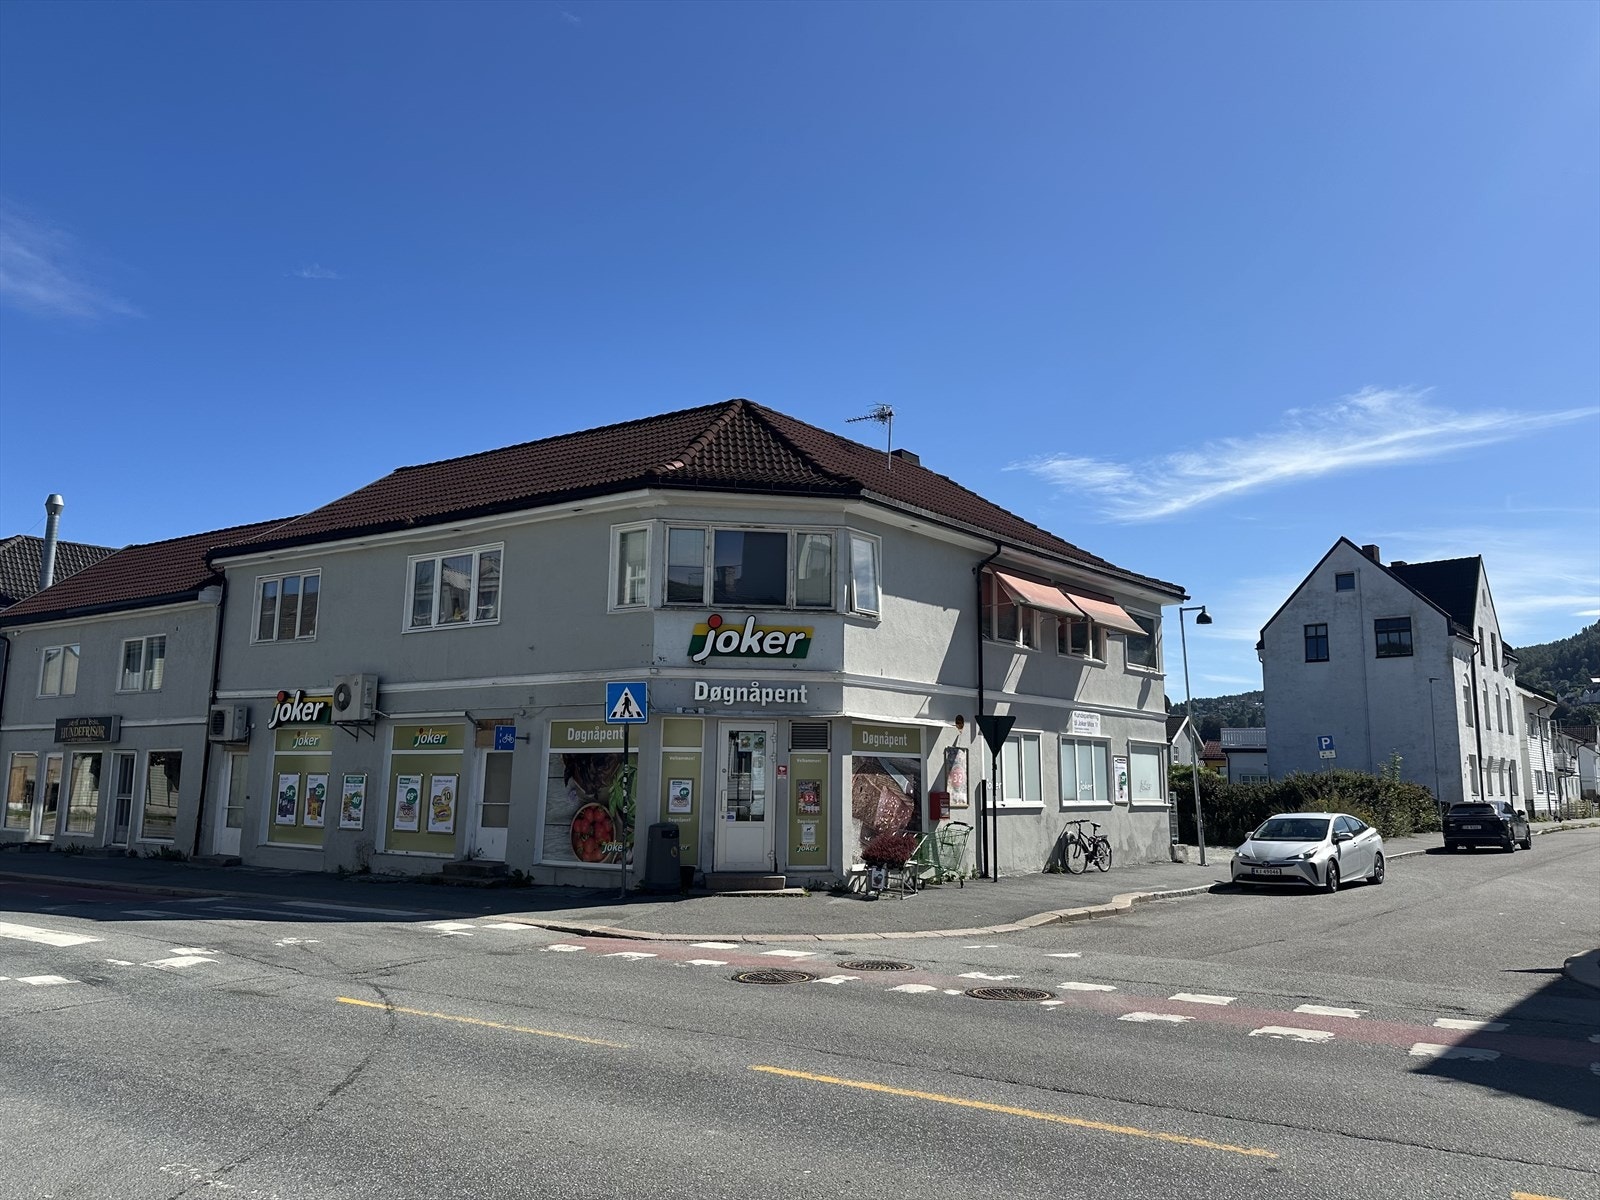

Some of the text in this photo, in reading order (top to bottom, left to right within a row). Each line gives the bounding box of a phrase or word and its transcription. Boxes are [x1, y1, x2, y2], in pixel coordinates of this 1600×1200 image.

[692, 614, 805, 662] joker
[694, 681, 808, 706] Døgnåpent
[268, 690, 324, 729] joker
[293, 731, 319, 749] joker
[414, 728, 446, 747] joker
[567, 727, 624, 743] Døgnåpent
[863, 731, 908, 748] Døgnåpent
[1321, 737, 1331, 749] P
[953, 773, 963, 783] 32
[602, 840, 624, 854] joke
[797, 843, 818, 853] joker
